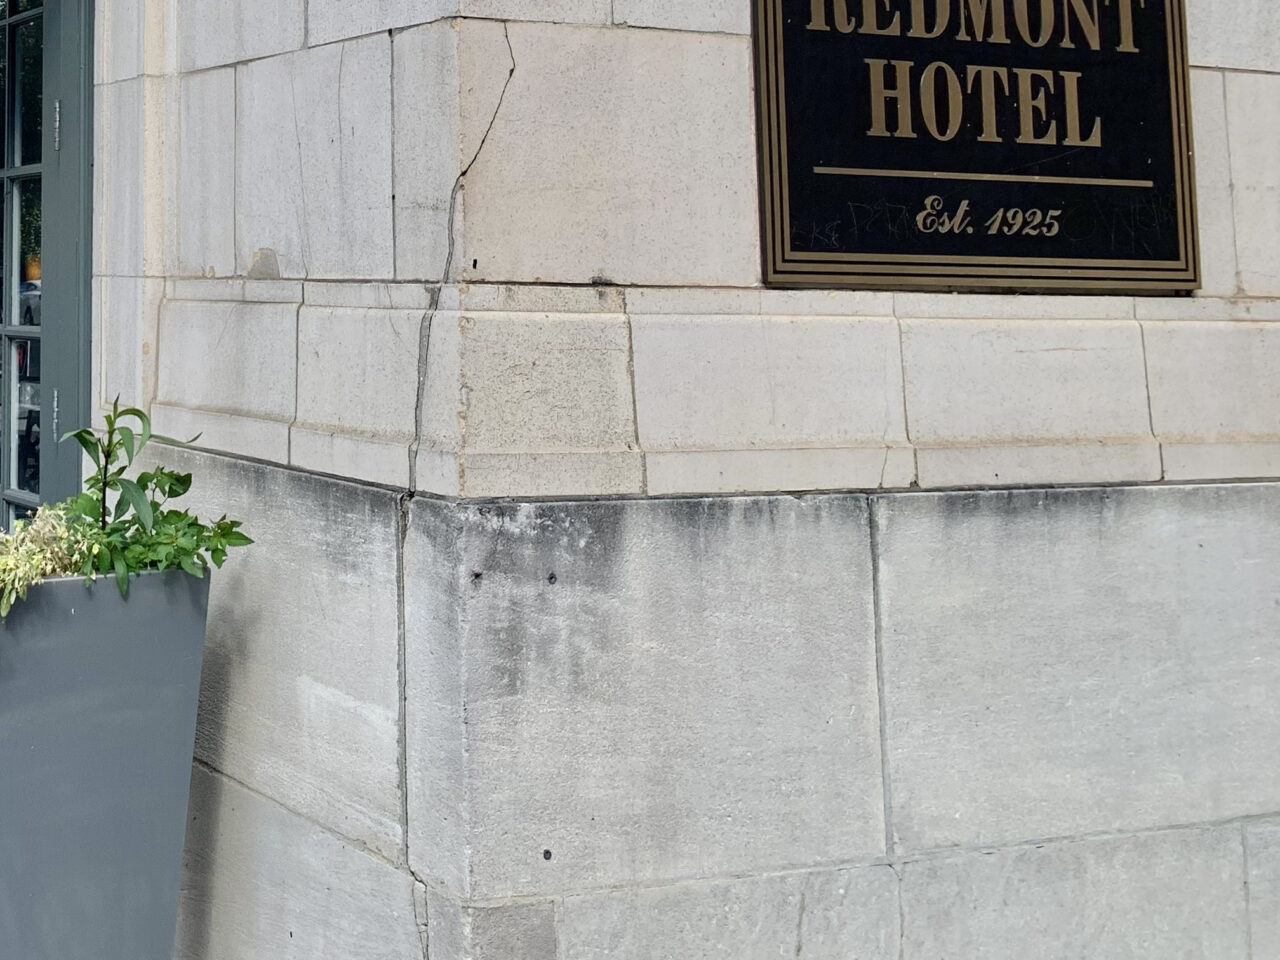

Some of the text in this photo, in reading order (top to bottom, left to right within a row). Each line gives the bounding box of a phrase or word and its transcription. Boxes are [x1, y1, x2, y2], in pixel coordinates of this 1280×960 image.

[863, 57, 1102, 148] HOTEL
[915, 194, 974, 235] Est.
[984, 207, 1063, 237] 1925
